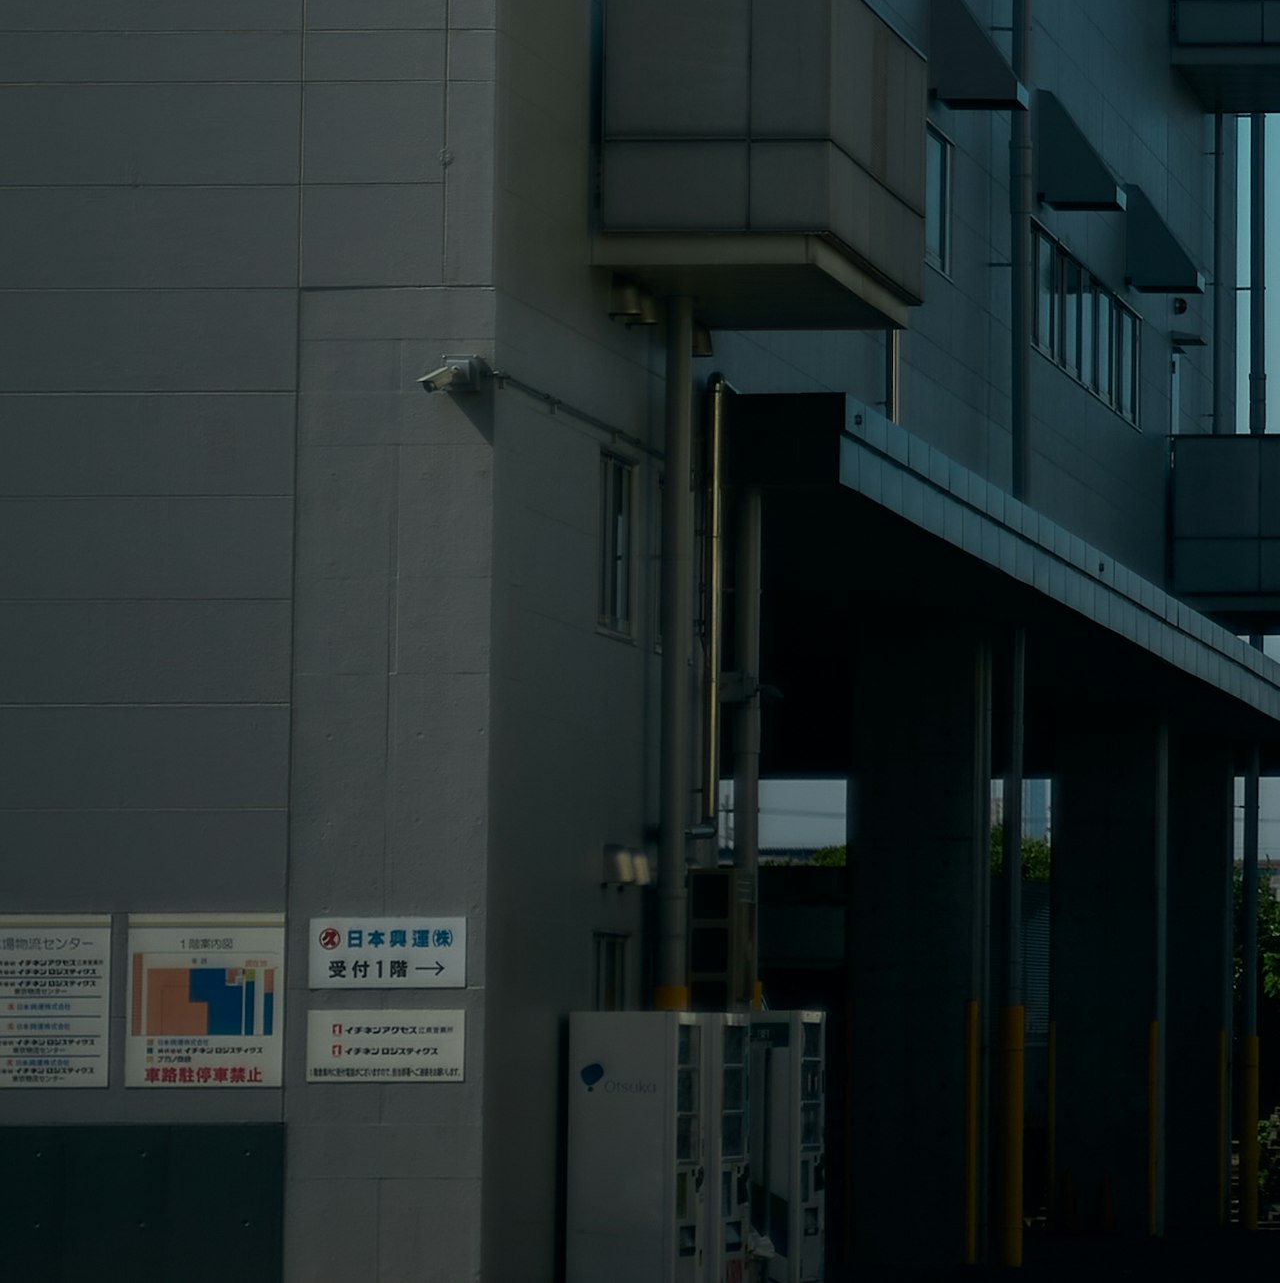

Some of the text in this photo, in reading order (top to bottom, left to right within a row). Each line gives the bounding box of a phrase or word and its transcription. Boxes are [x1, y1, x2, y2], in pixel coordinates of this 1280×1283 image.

[328, 960, 408, 978] 受付1階
[144, 1067, 263, 1083] 車路駐停車禁止
[603, 1079, 657, 1094] Otsuka
